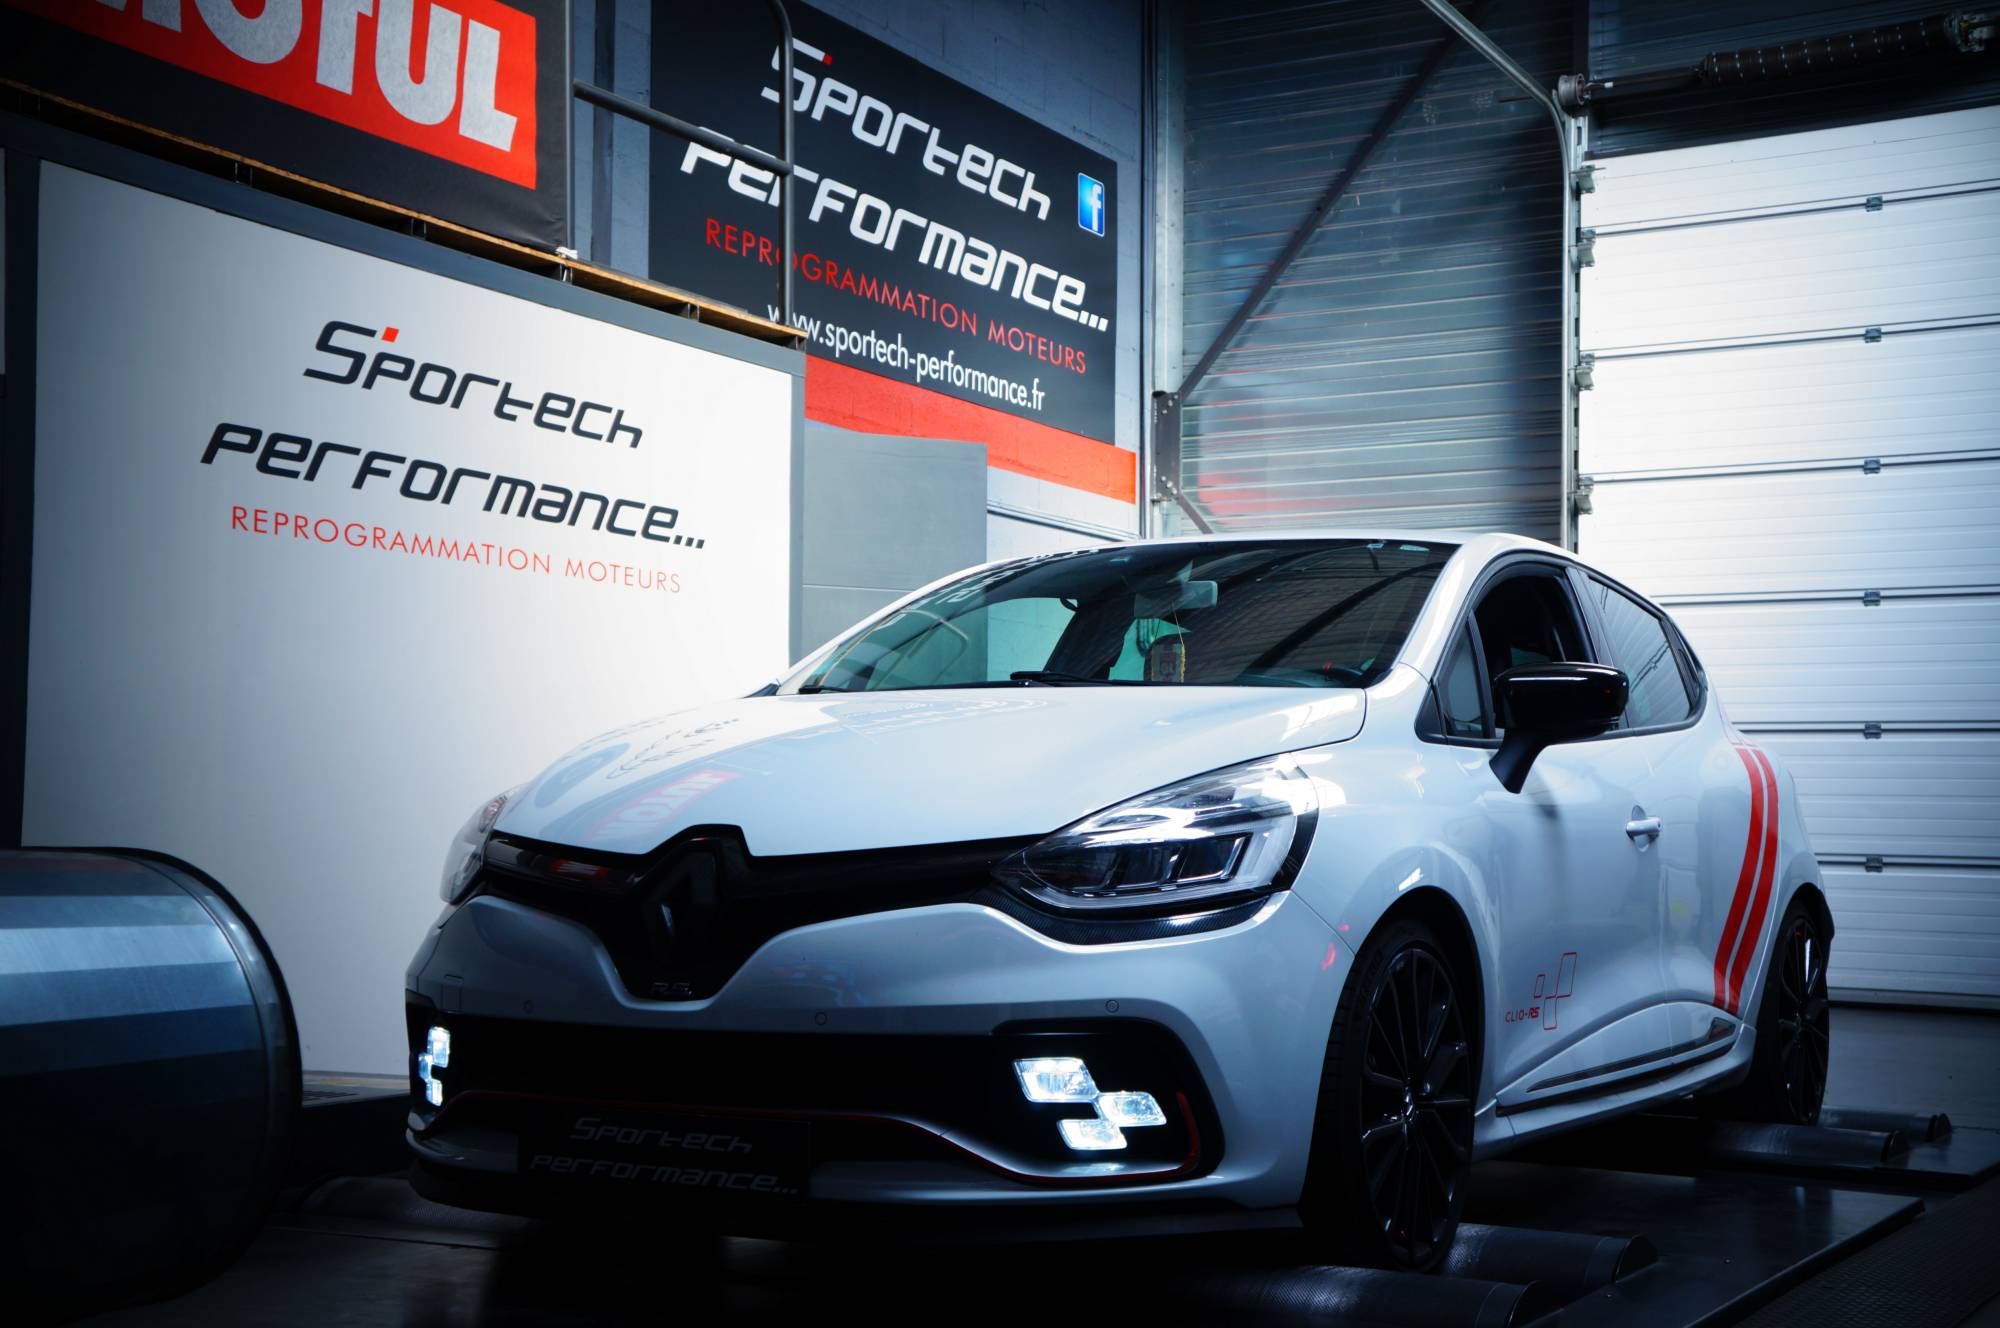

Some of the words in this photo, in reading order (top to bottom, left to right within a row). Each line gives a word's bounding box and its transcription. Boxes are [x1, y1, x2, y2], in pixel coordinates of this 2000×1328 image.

[761, 37, 1051, 220] Sportech
[303, 320, 643, 449] Sportech
[988, 320, 1087, 374] MOTEURS
[231, 505, 551, 575] REPROGRAMMATION
[564, 557, 682, 594] MOTEURS
[568, 1115, 753, 1154] Sportech
